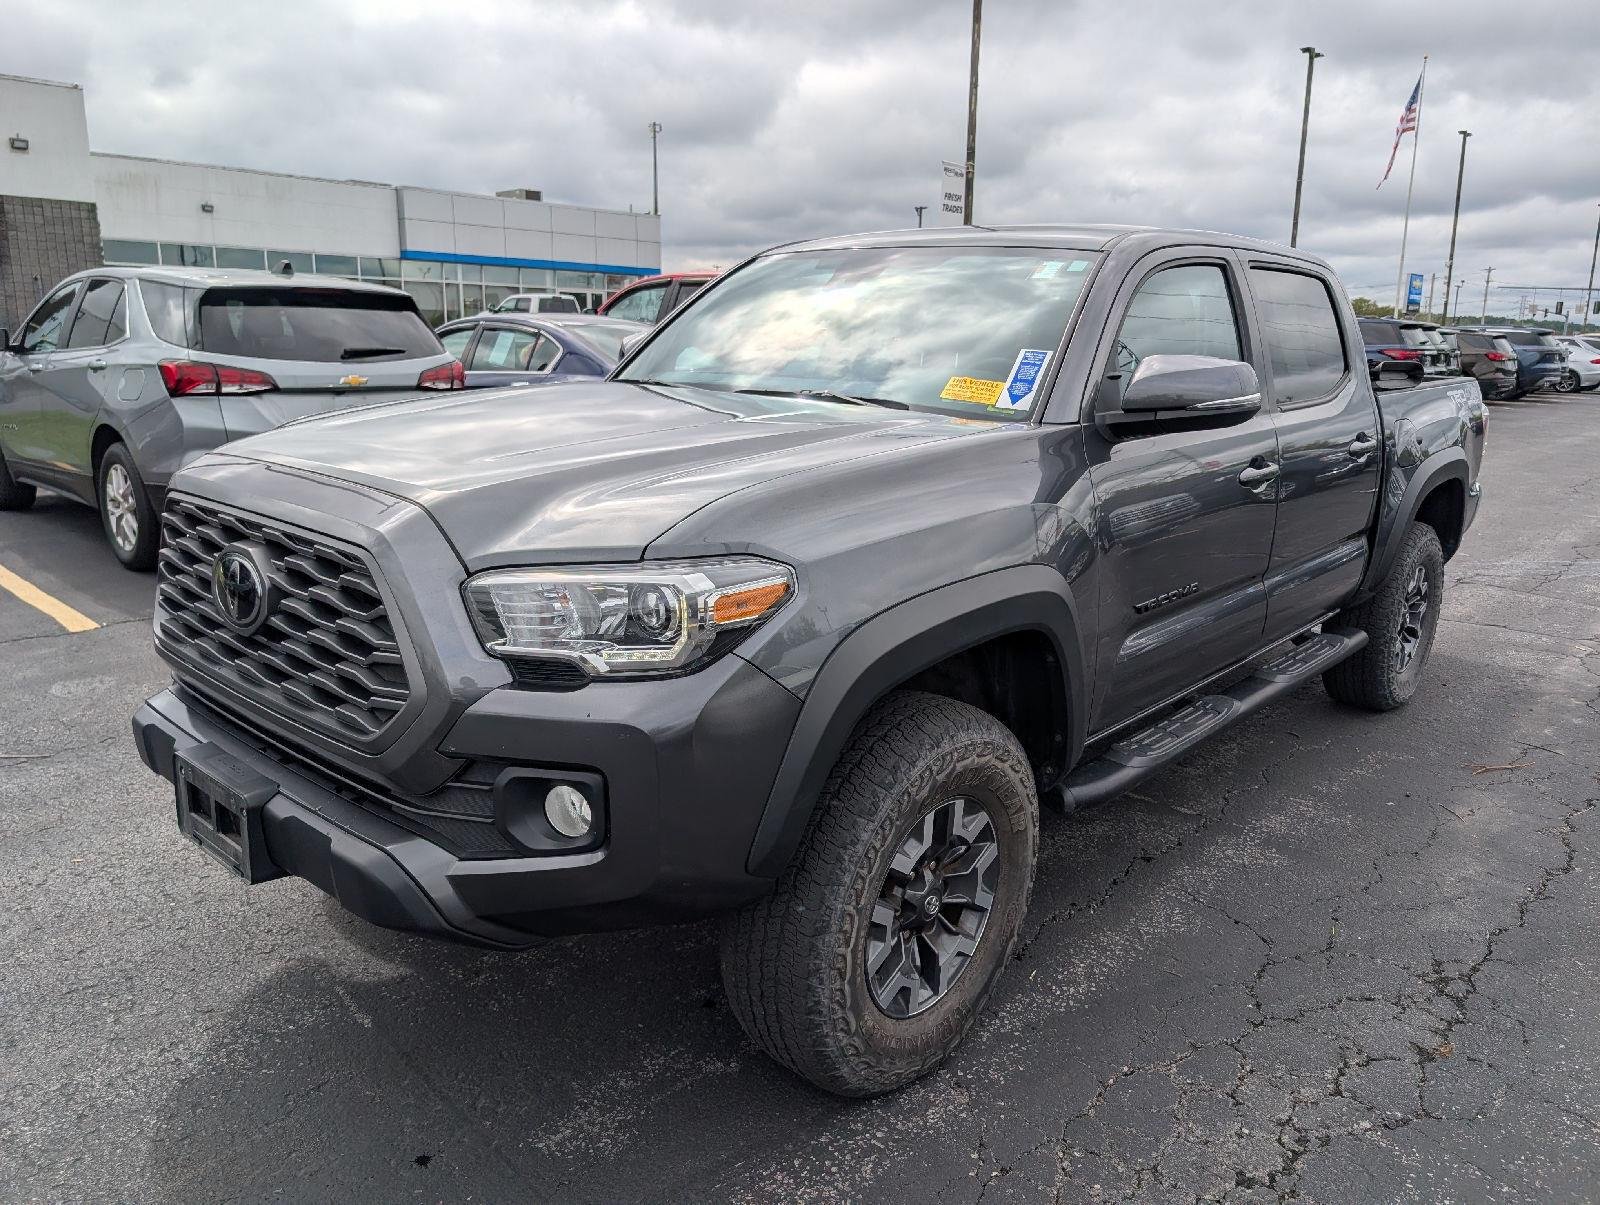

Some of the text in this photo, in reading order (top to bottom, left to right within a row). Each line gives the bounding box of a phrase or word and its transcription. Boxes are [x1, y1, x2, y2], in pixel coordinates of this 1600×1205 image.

[944, 192, 962, 202] FRESH
[943, 203, 963, 214] TRADES
[969, 379, 1001, 389] VEHICLE
[1133, 581, 1199, 614] TACOMA
